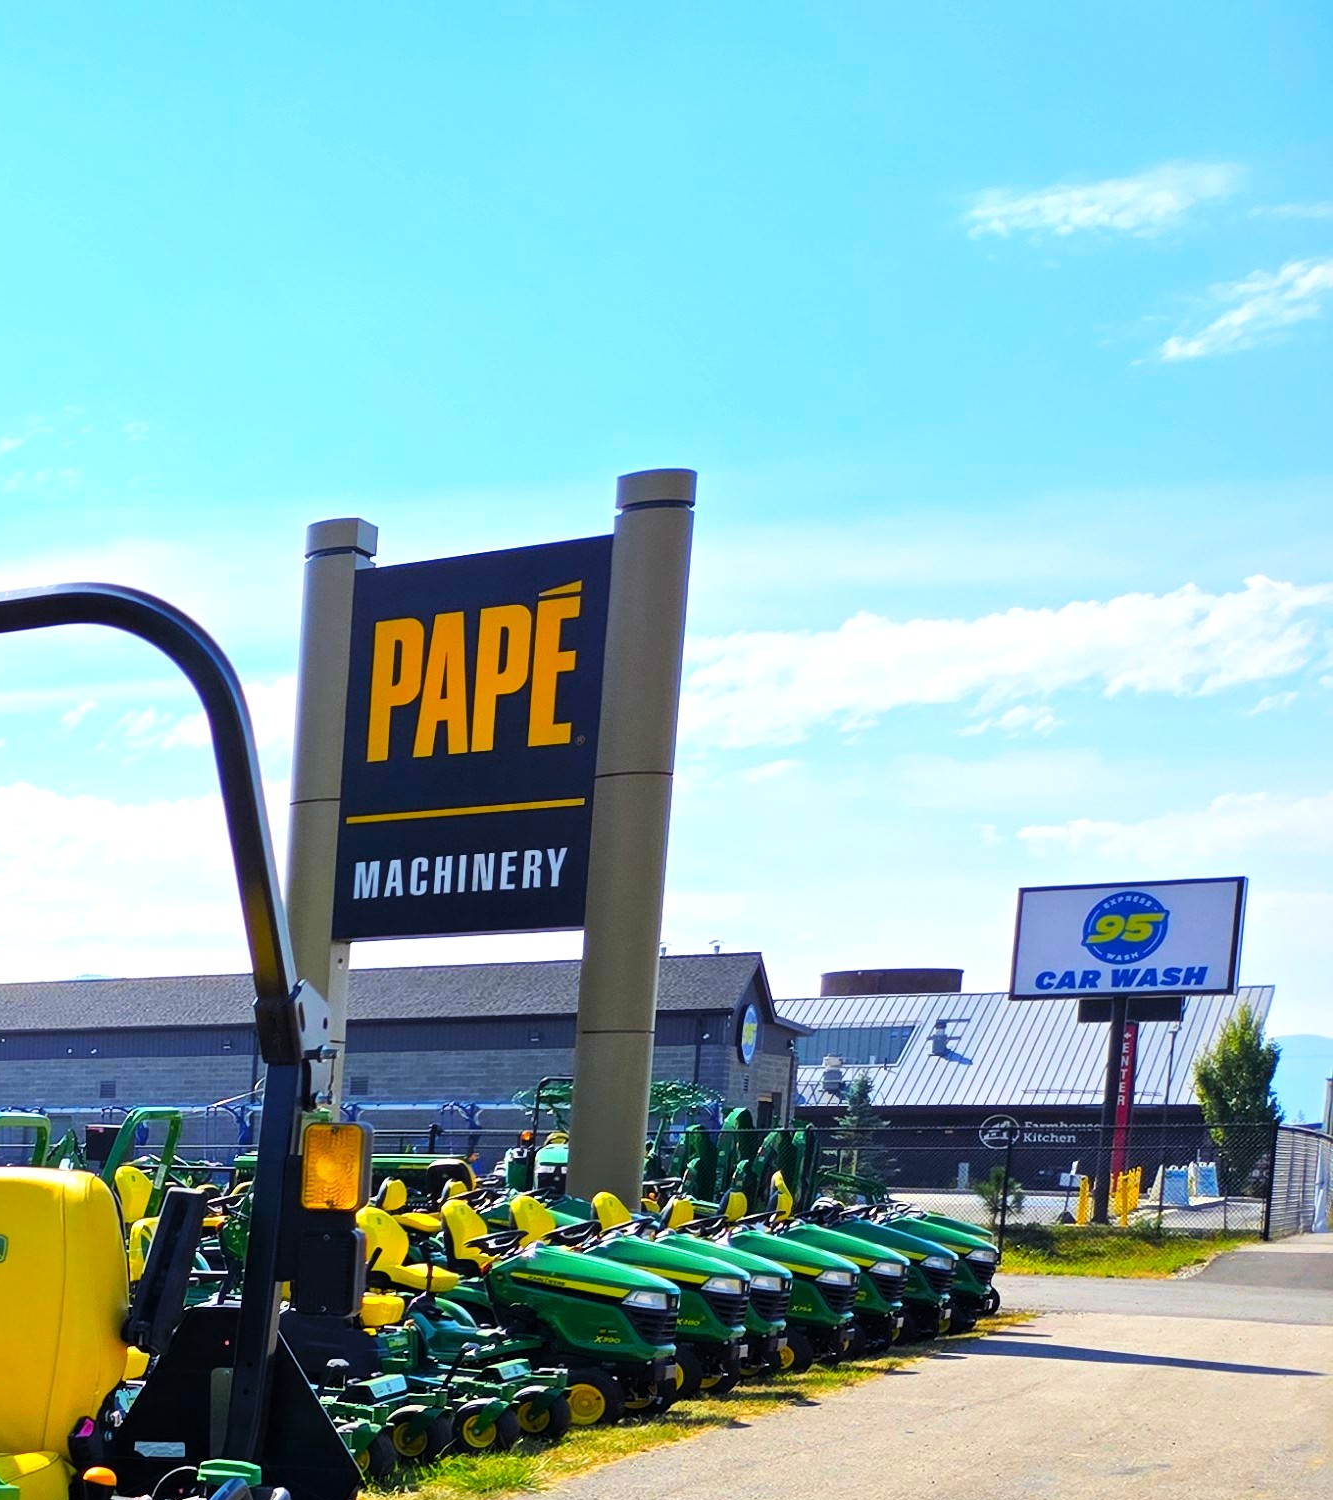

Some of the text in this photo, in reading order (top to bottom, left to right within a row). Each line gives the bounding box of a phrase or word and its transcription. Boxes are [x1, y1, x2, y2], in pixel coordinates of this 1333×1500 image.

[366, 580, 582, 762] PAPÉ
[352, 847, 568, 900] MACHINERY
[1102, 895, 1153, 909] EXPRESS
[1085, 912, 1167, 944] 95
[1106, 951, 1139, 962] WASH
[1035, 966, 1209, 990] CAR WASH
[1117, 1042, 1130, 1106] ENTER
[1023, 1132, 1076, 1144] Kitchen
